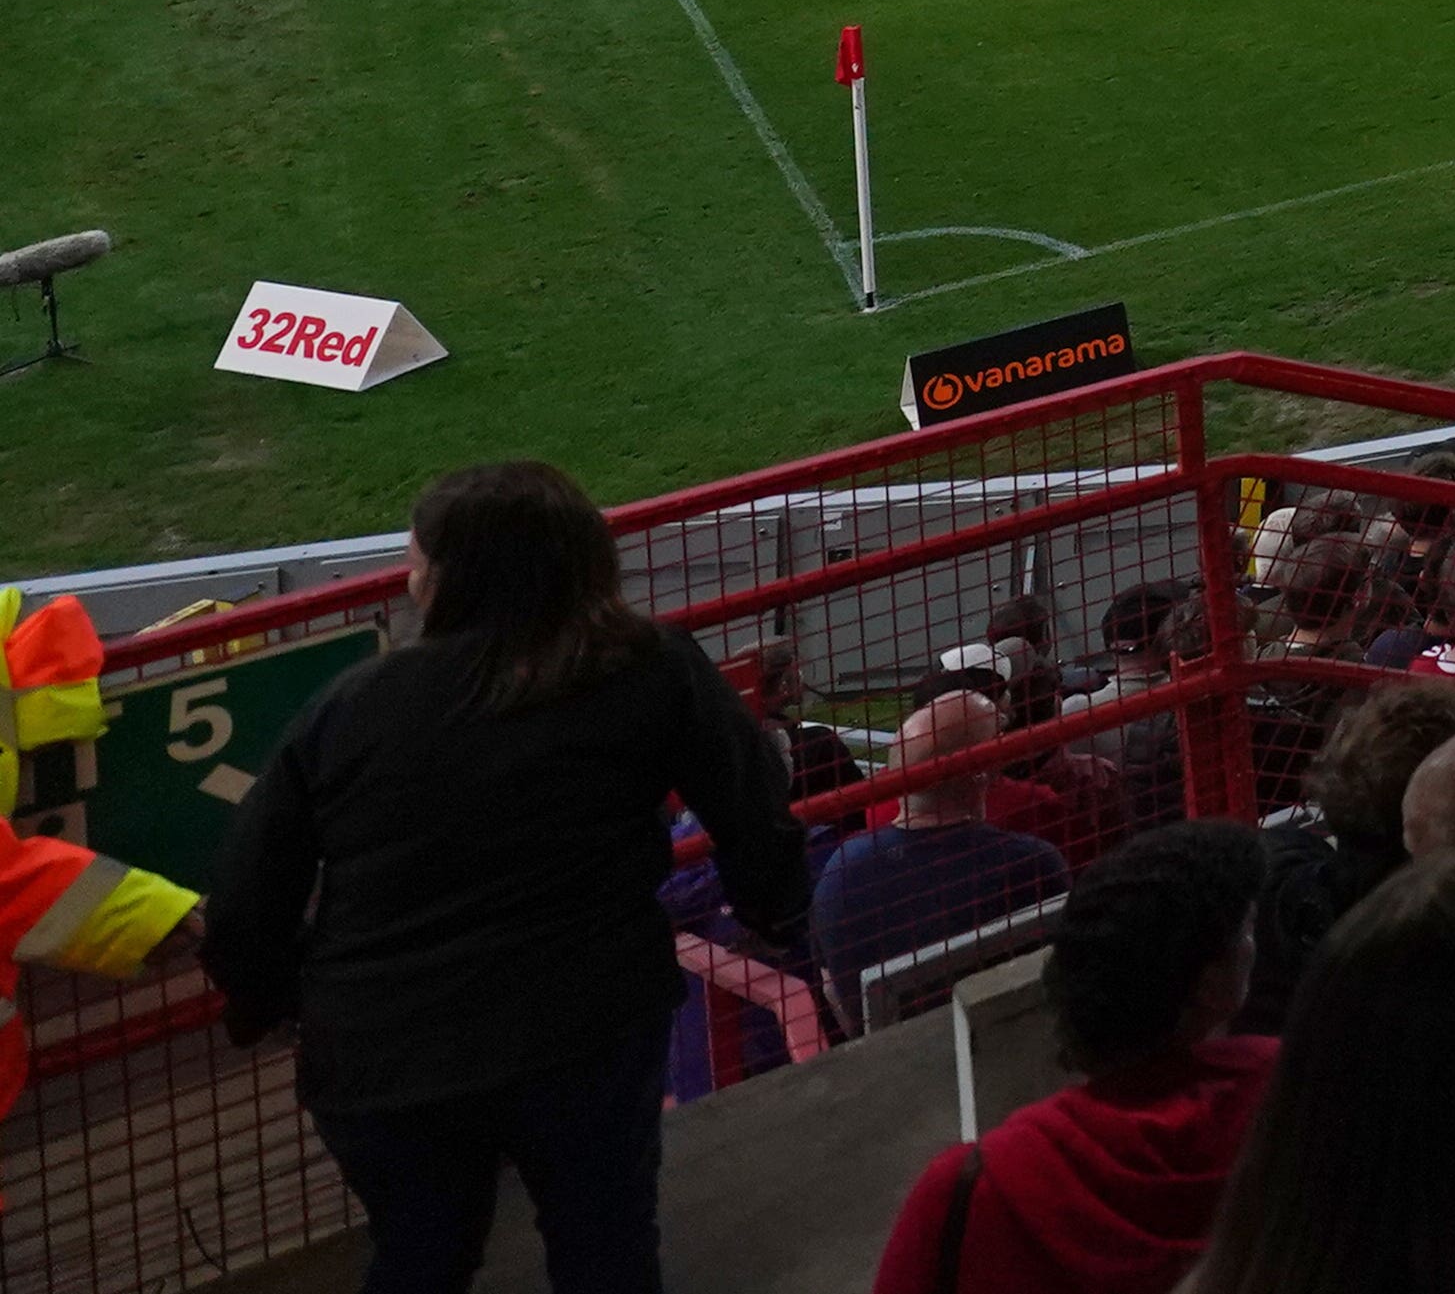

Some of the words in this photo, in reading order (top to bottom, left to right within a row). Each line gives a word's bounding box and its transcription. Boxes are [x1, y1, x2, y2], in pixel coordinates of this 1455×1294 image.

[236, 308, 379, 368] 32Red
[964, 331, 1127, 395] vanarama
[166, 676, 235, 763] 5
